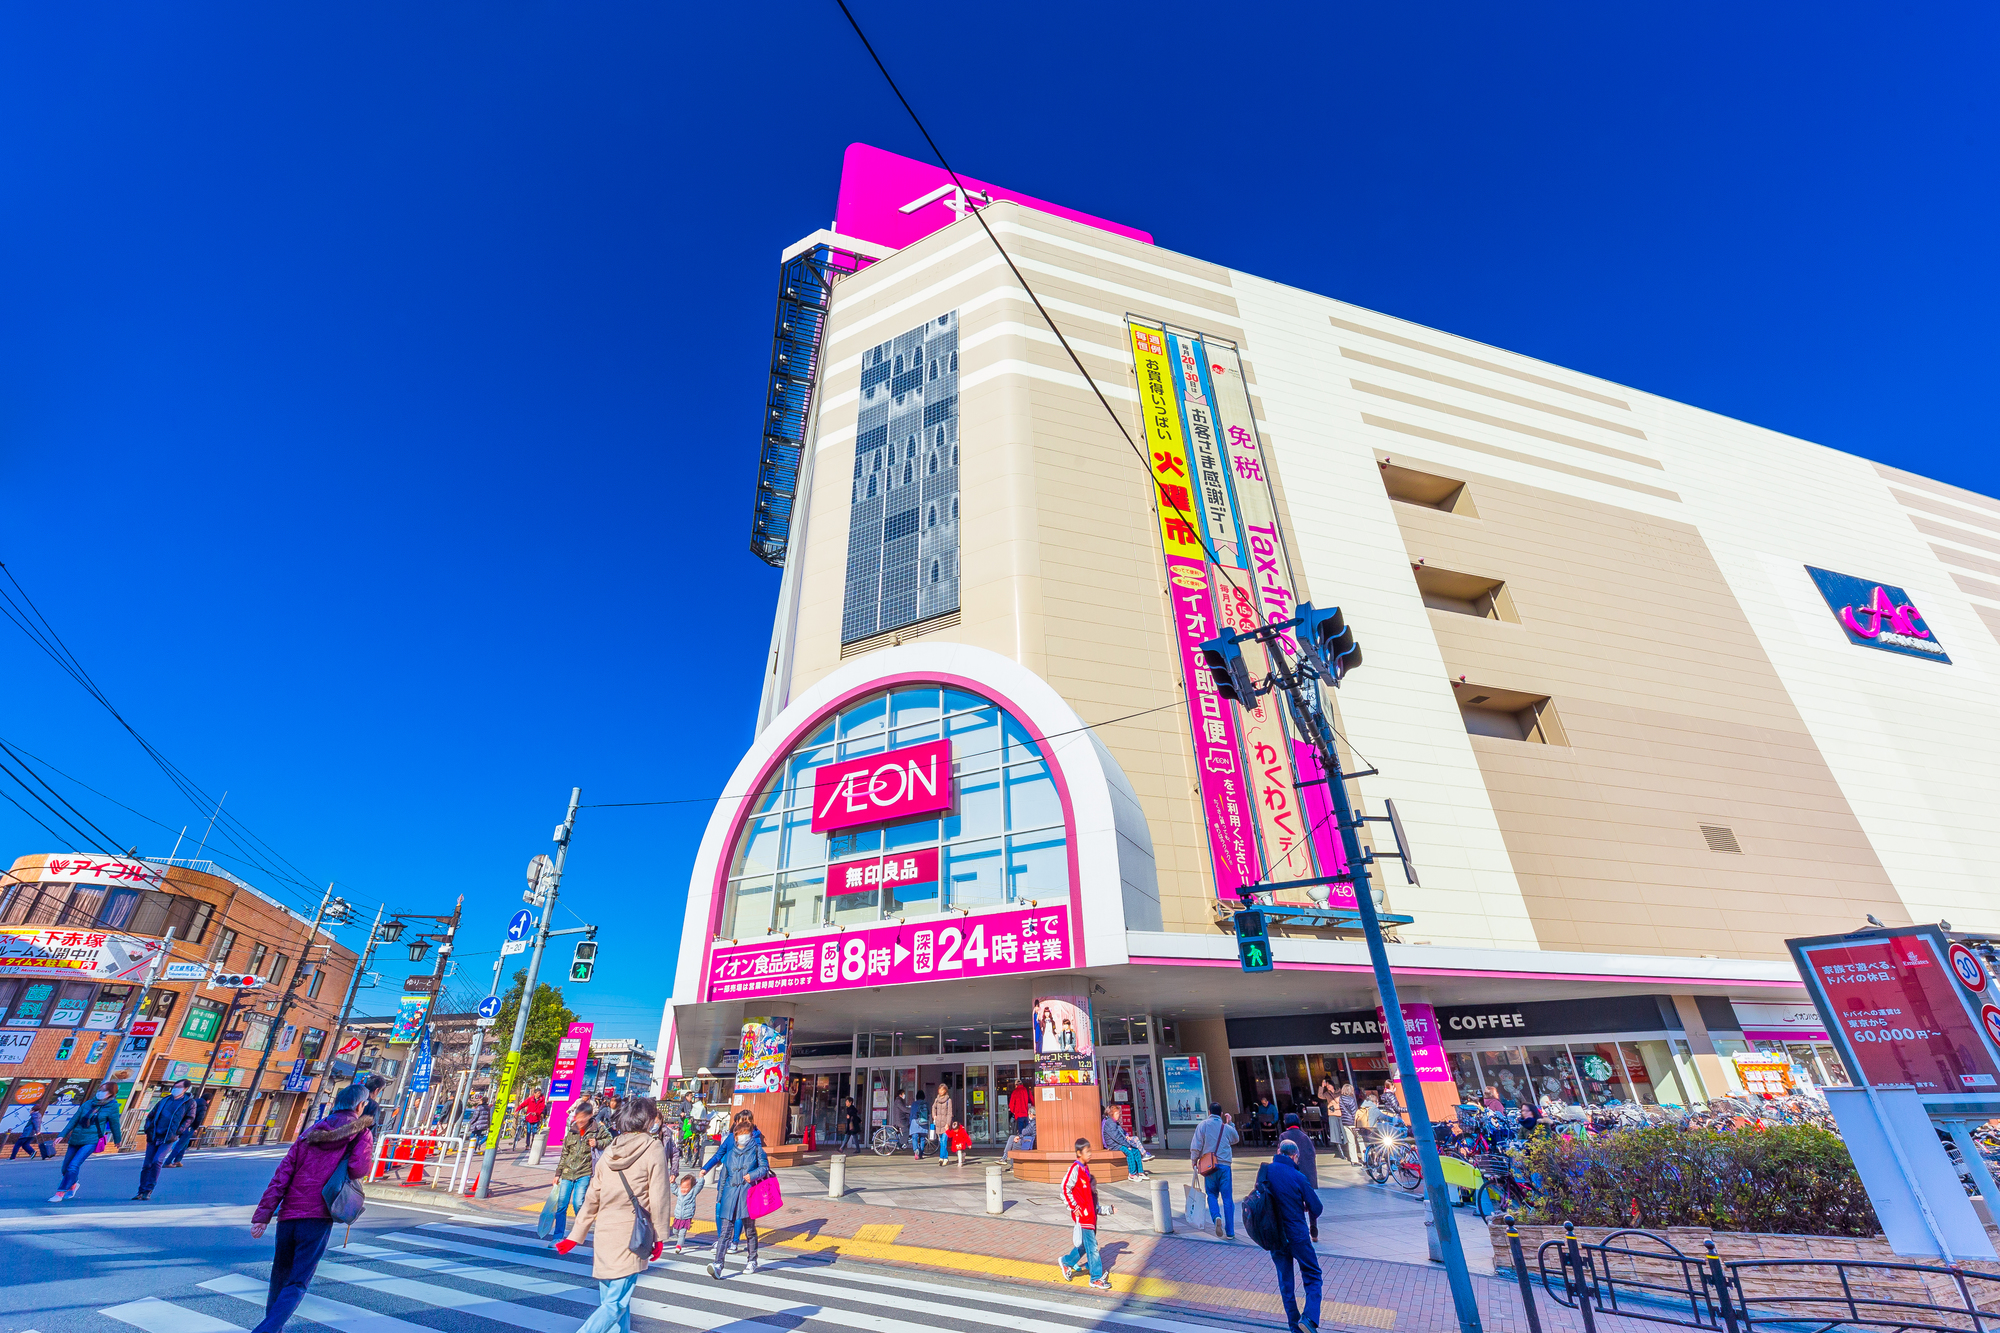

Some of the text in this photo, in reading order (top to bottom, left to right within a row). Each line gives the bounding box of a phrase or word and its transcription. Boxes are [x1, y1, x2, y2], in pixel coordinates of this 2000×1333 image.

[1146, 359, 1172, 441] お買得いっぱい
[1227, 424, 1263, 482] 免税
[1191, 408, 1227, 534] お客さま感謝デー
[1154, 451, 1196, 545] 火曜市
[1254, 742, 1297, 868] わくわくデー
[70, 860, 148, 882] アイフル
[845, 858, 918, 888] 無印良品
[1021, 915, 1058, 938] まで
[44, 931, 107, 948] 下赤塚
[1022, 937, 1063, 964] 営業
[715, 949, 814, 978] イオン食品売場
[1821, 960, 1897, 975] 家族で遊べる、
[1903, 959, 1929, 967] Emirates
[1957, 957, 1978, 980] 30
[1827, 971, 1896, 986] ドバイの休日。
[1450, 1013, 1526, 1030] COFFEE
[1843, 1008, 1902, 1017] ドバイへの運賃は
[1848, 1017, 1888, 1028] 東京から
